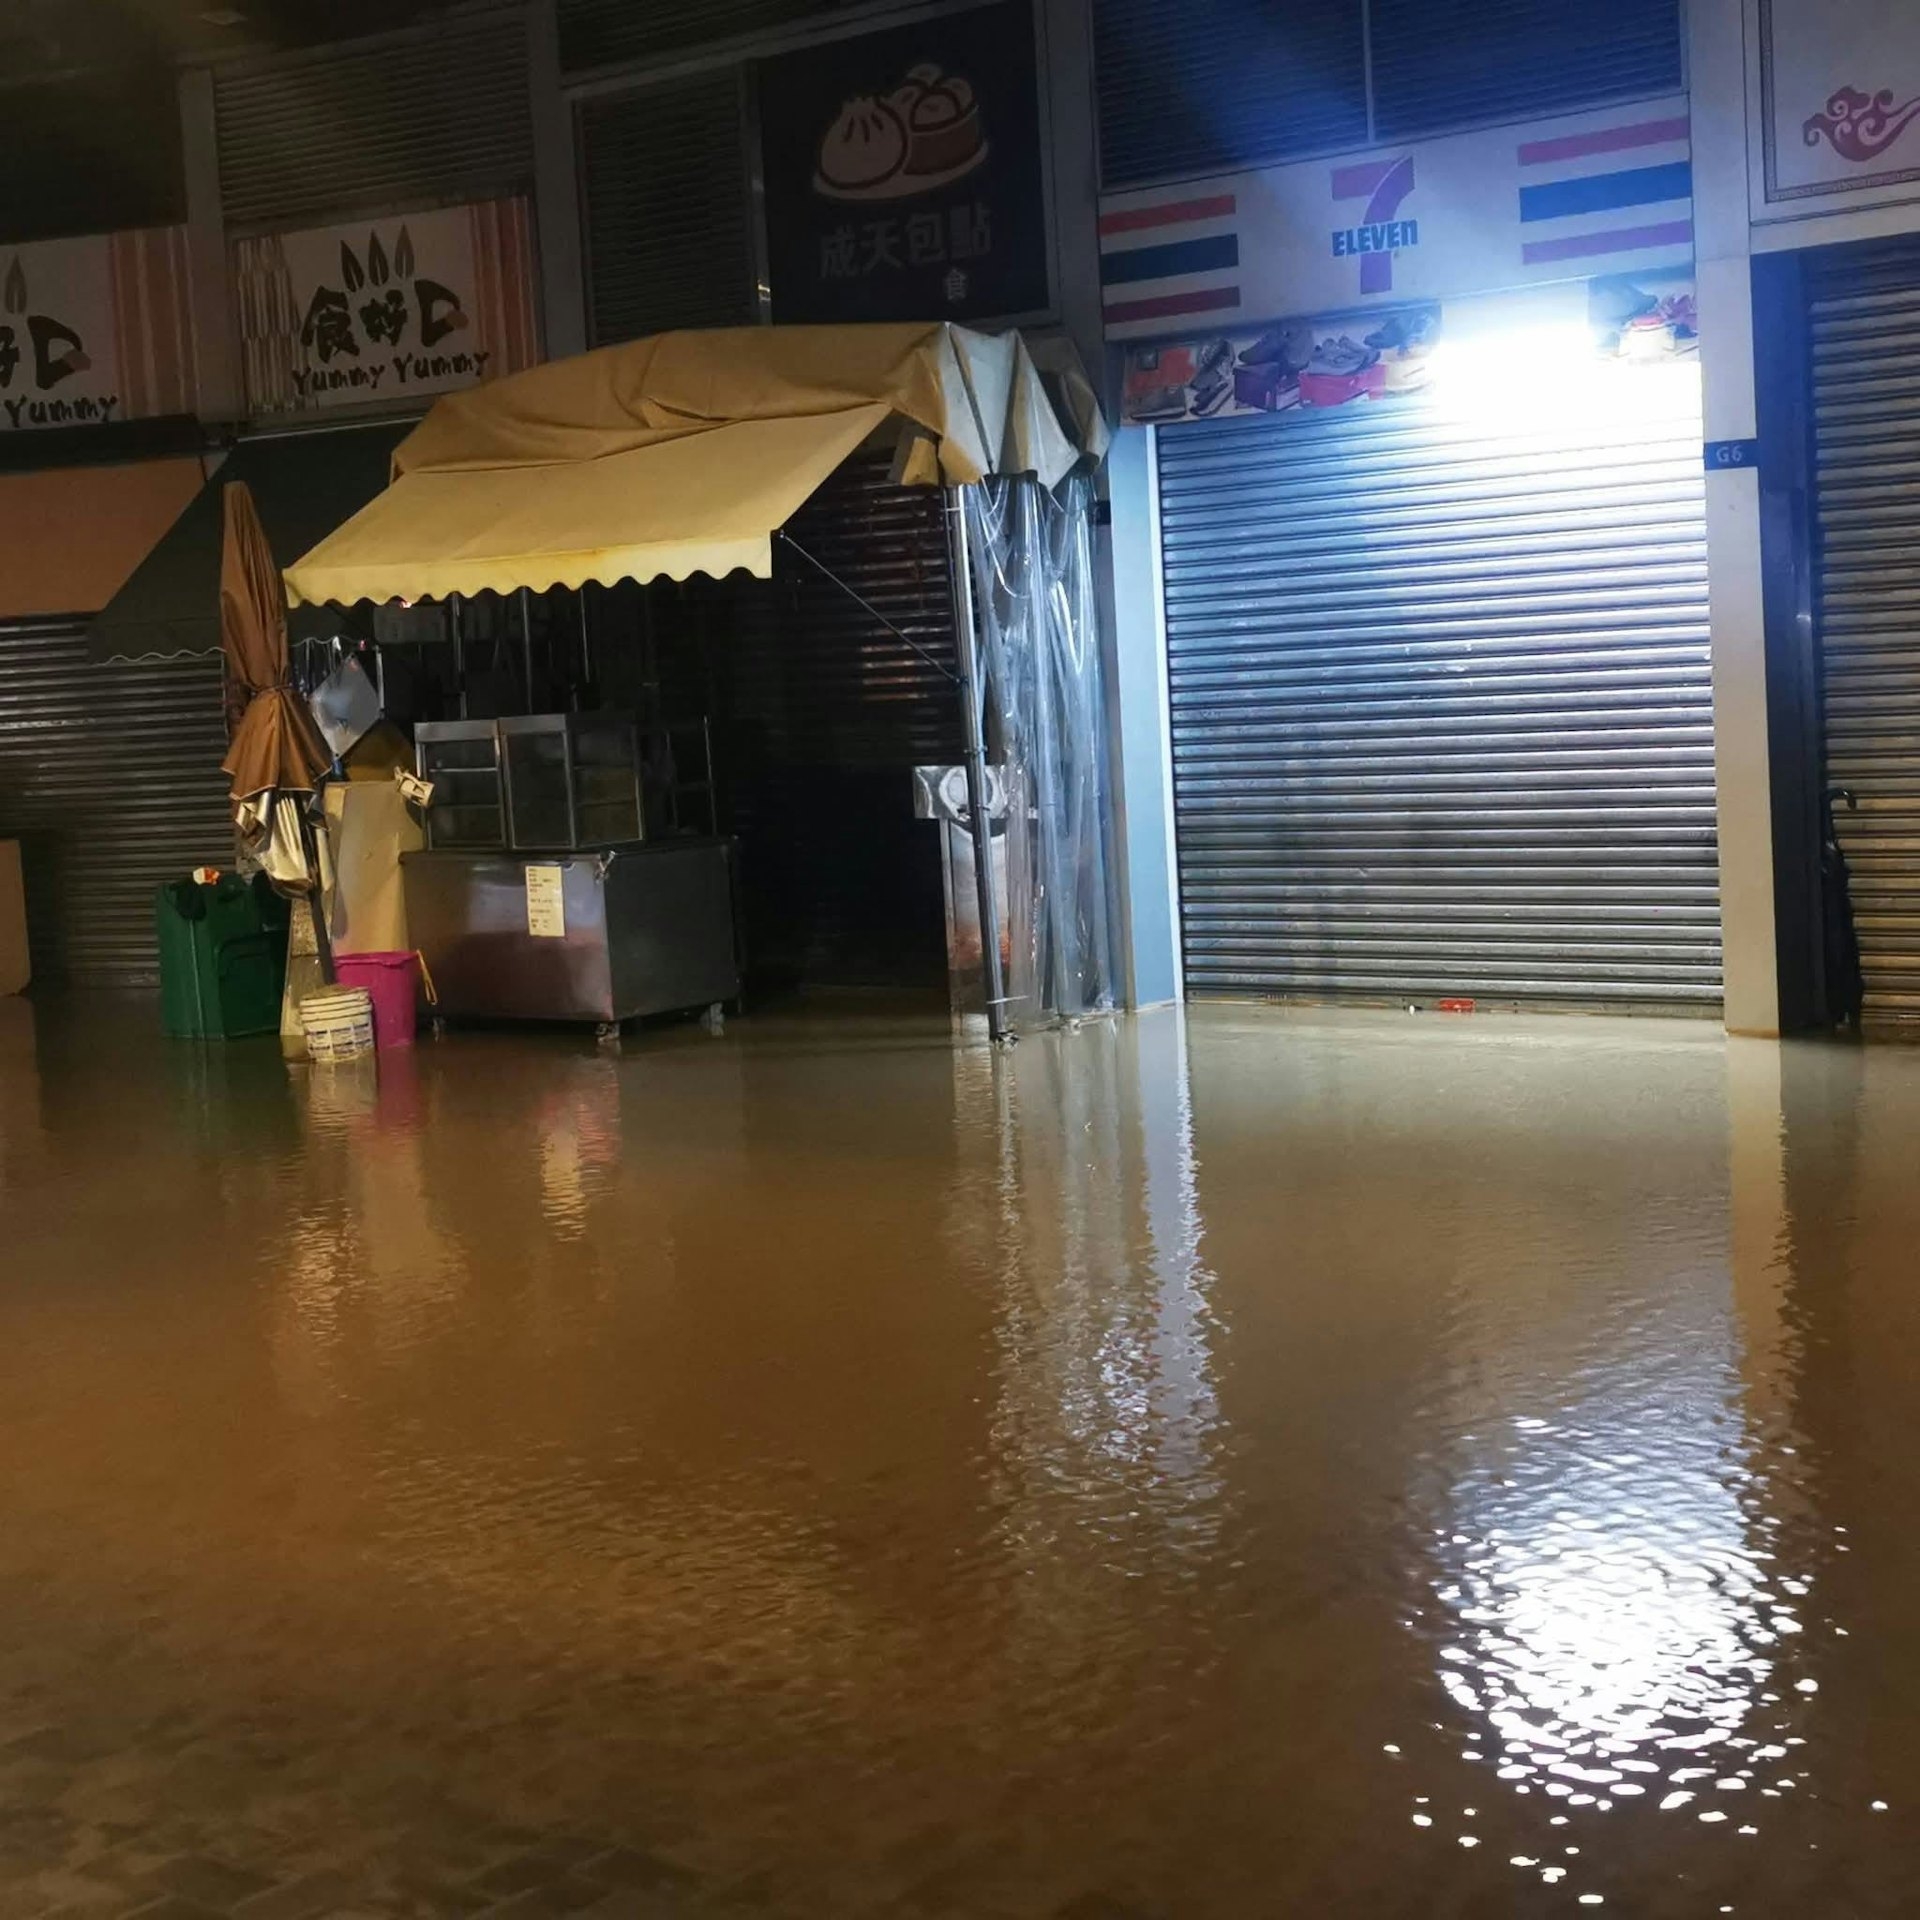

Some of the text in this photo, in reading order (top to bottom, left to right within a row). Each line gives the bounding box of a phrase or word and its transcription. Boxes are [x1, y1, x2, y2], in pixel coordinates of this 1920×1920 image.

[1330, 155, 1415, 294] 7
[393, 351, 491, 383] Yummy
[1716, 445, 1743, 462] G6
